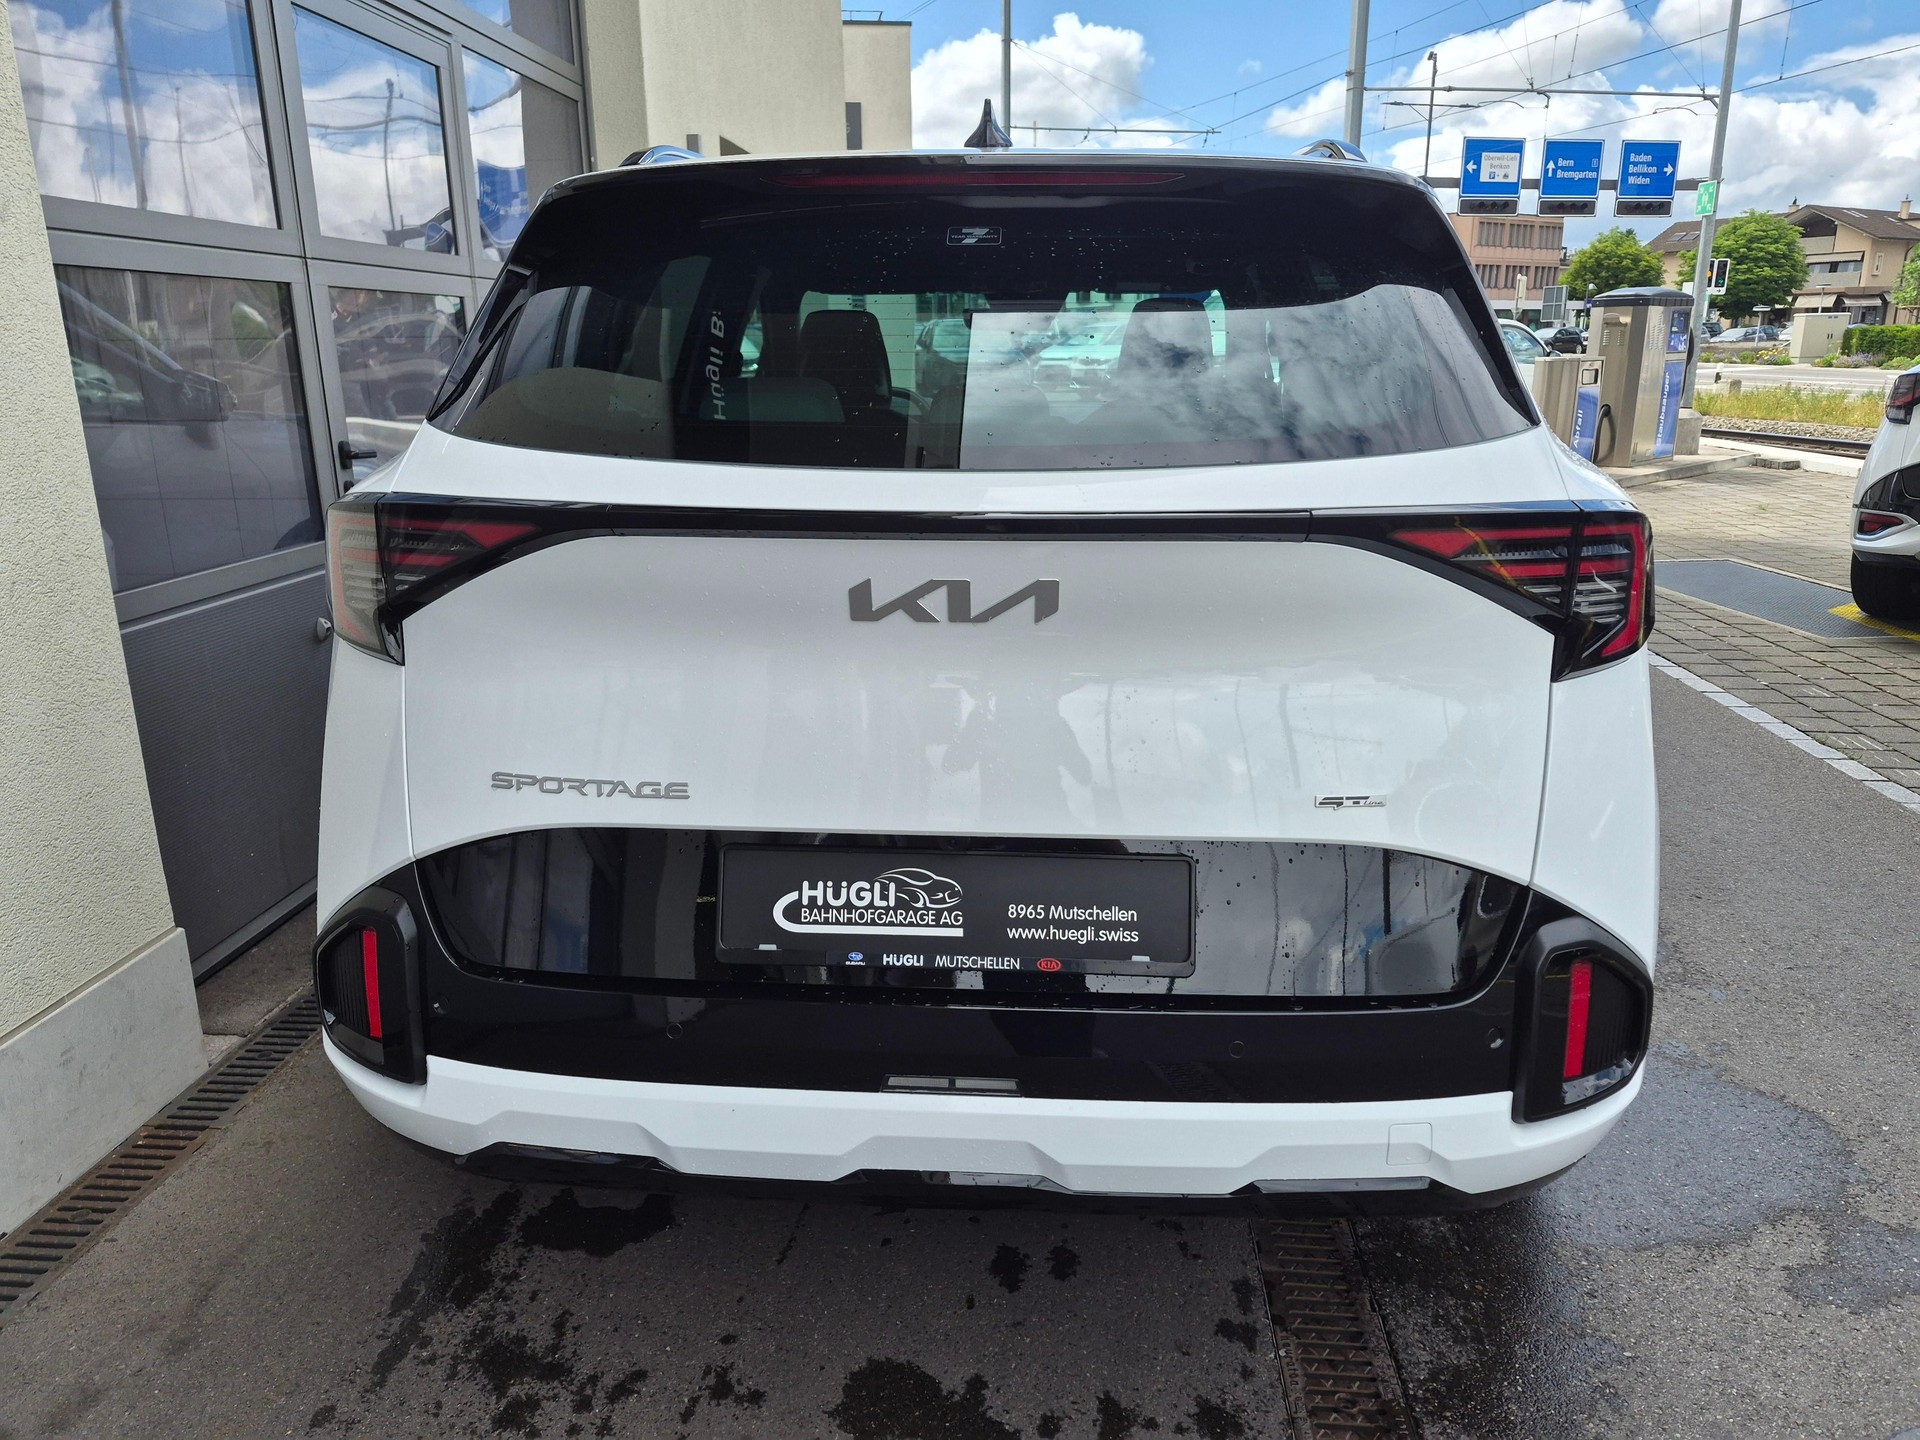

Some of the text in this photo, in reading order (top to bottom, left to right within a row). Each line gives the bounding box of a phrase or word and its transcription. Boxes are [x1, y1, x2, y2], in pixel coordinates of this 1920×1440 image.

[1558, 158, 1574, 167] Bern
[1630, 153, 1652, 162] Baden
[1557, 169, 1598, 180] Bremgarten
[1628, 164, 1657, 173] Bellikon
[1628, 176, 1650, 184] Widen
[1655, 372, 1671, 447] Staubsauger
[1573, 409, 1584, 449] Abfall
[848, 577, 1060, 624] KIA
[491, 771, 691, 800] SPORTAGE
[802, 880, 896, 907] HÜGLI
[801, 908, 963, 925] BAHNHOFGARAGE AG
[1008, 904, 1137, 921] 8965 Mutschellen
[1007, 925, 1139, 944] www.huegli.swiss
[882, 954, 924, 967] HÜGLI
[935, 955, 1020, 970] MUTSCHELLEN
